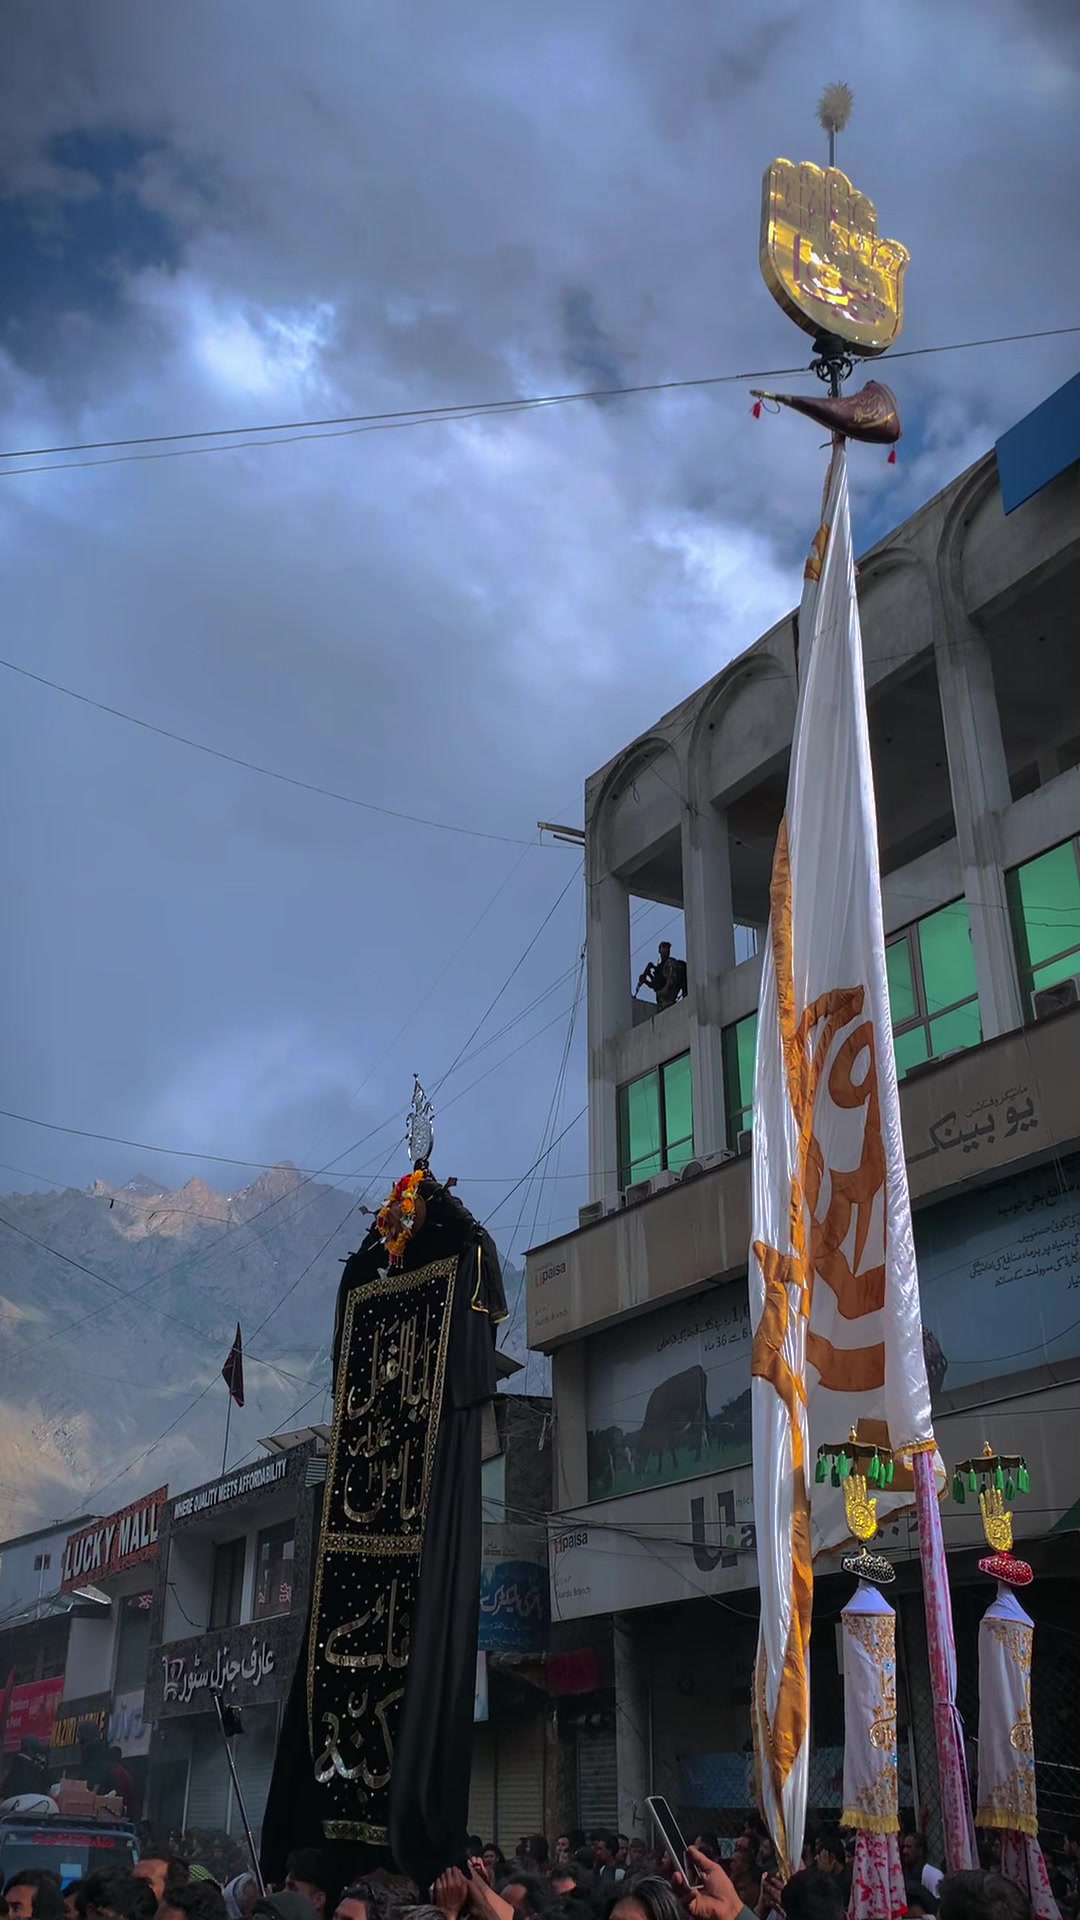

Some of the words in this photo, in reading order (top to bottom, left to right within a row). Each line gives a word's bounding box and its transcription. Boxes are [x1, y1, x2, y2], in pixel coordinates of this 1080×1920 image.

[716, 1334, 727, 1348] 36
[173, 1497, 194, 1520] WHERE
[193, 1487, 218, 1512] QUALITY
[217, 1478, 239, 1503] MEETS
[237, 1458, 288, 1495] AFFORDABILITY
[64, 1524, 117, 1581] LUCKY
[118, 1503, 159, 1558] MALL
[178, 1653, 209, 1703] سٹور
[209, 1646, 241, 1693] جنرل
[241, 1636, 275, 1686] عارف
